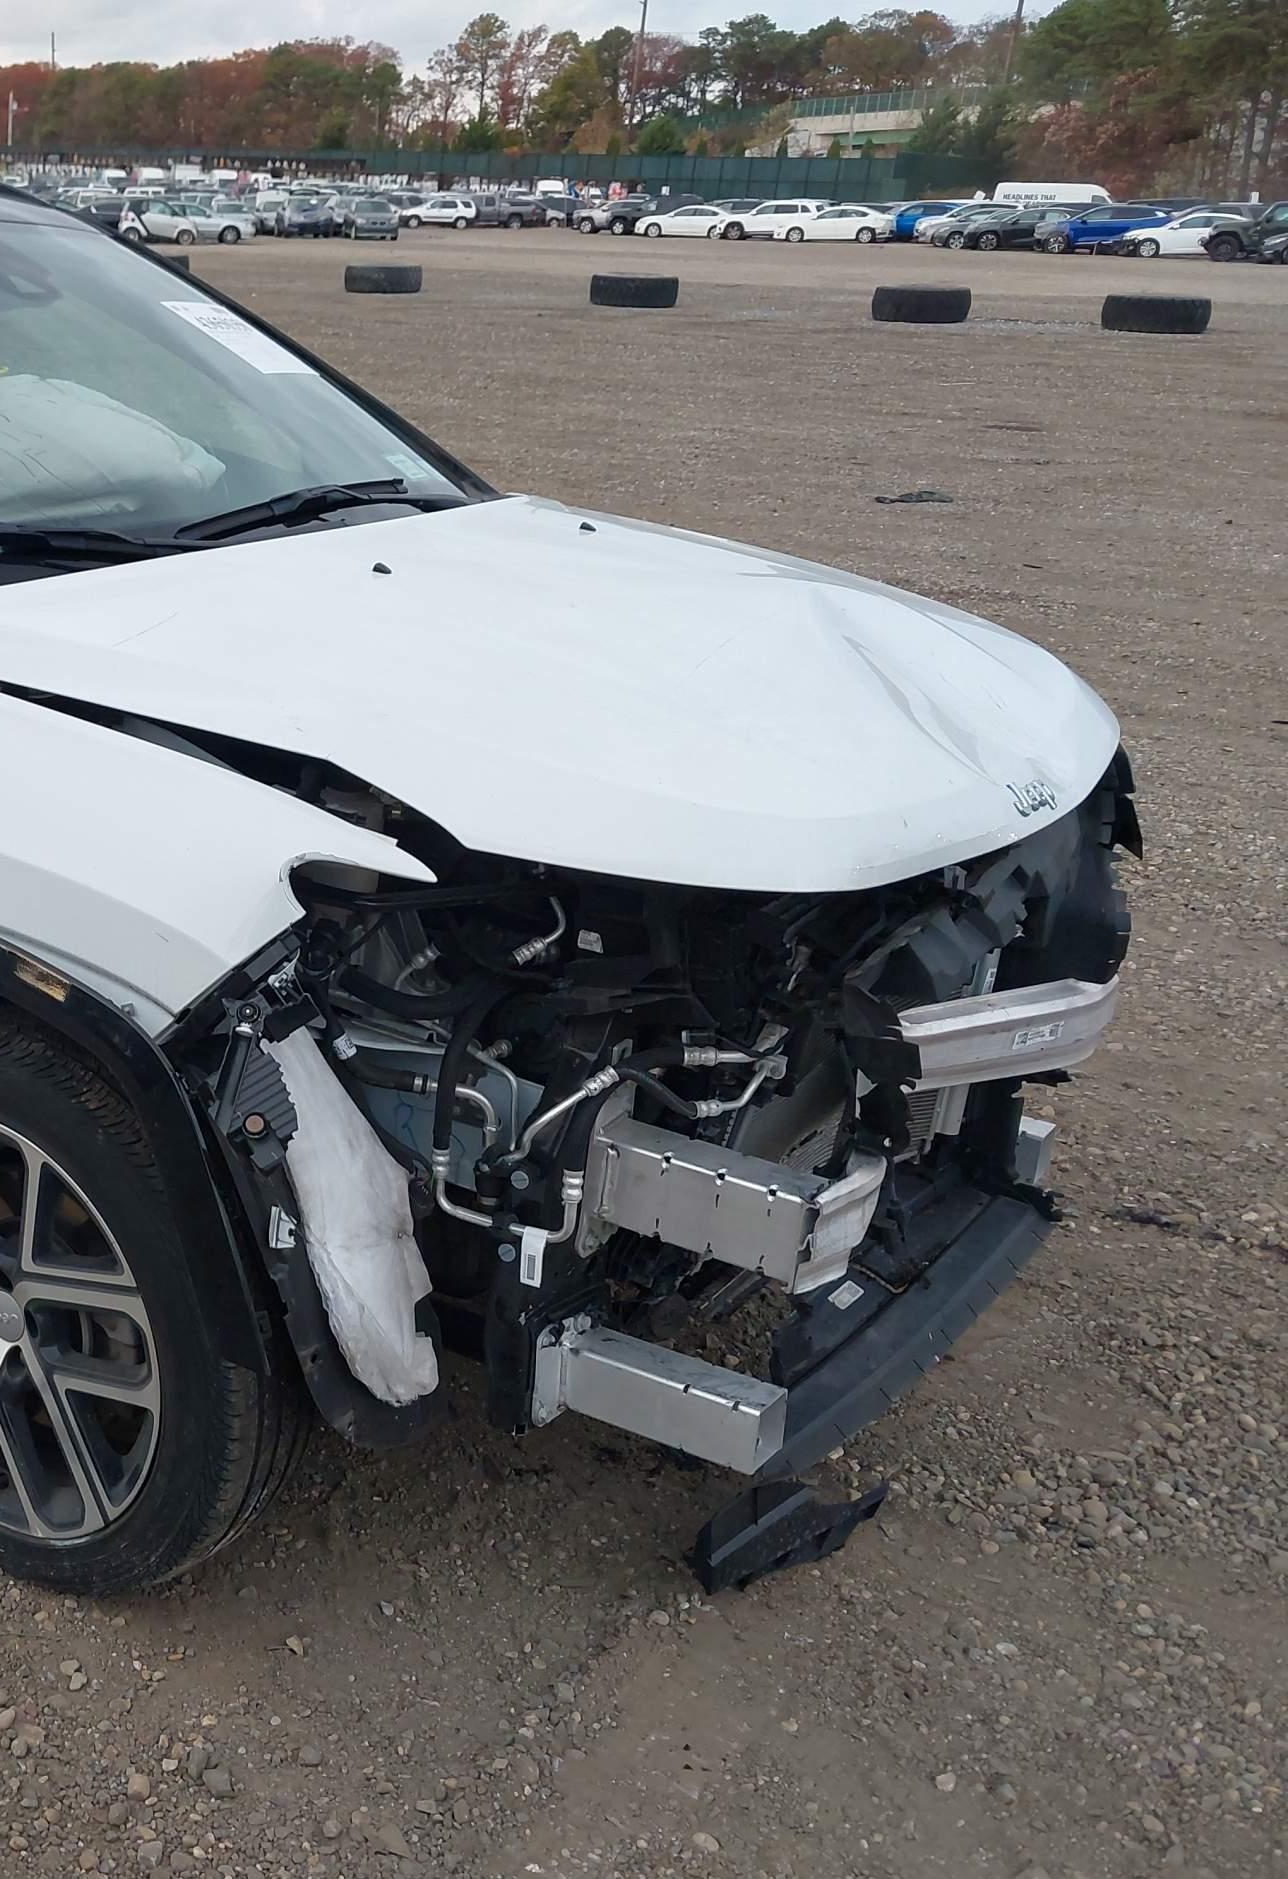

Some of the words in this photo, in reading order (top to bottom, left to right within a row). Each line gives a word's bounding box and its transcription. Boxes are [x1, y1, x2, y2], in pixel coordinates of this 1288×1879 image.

[1002, 193, 1039, 201] HEADLINES
[1040, 193, 1057, 201] THAT
[1005, 781, 1057, 817] Jeep
